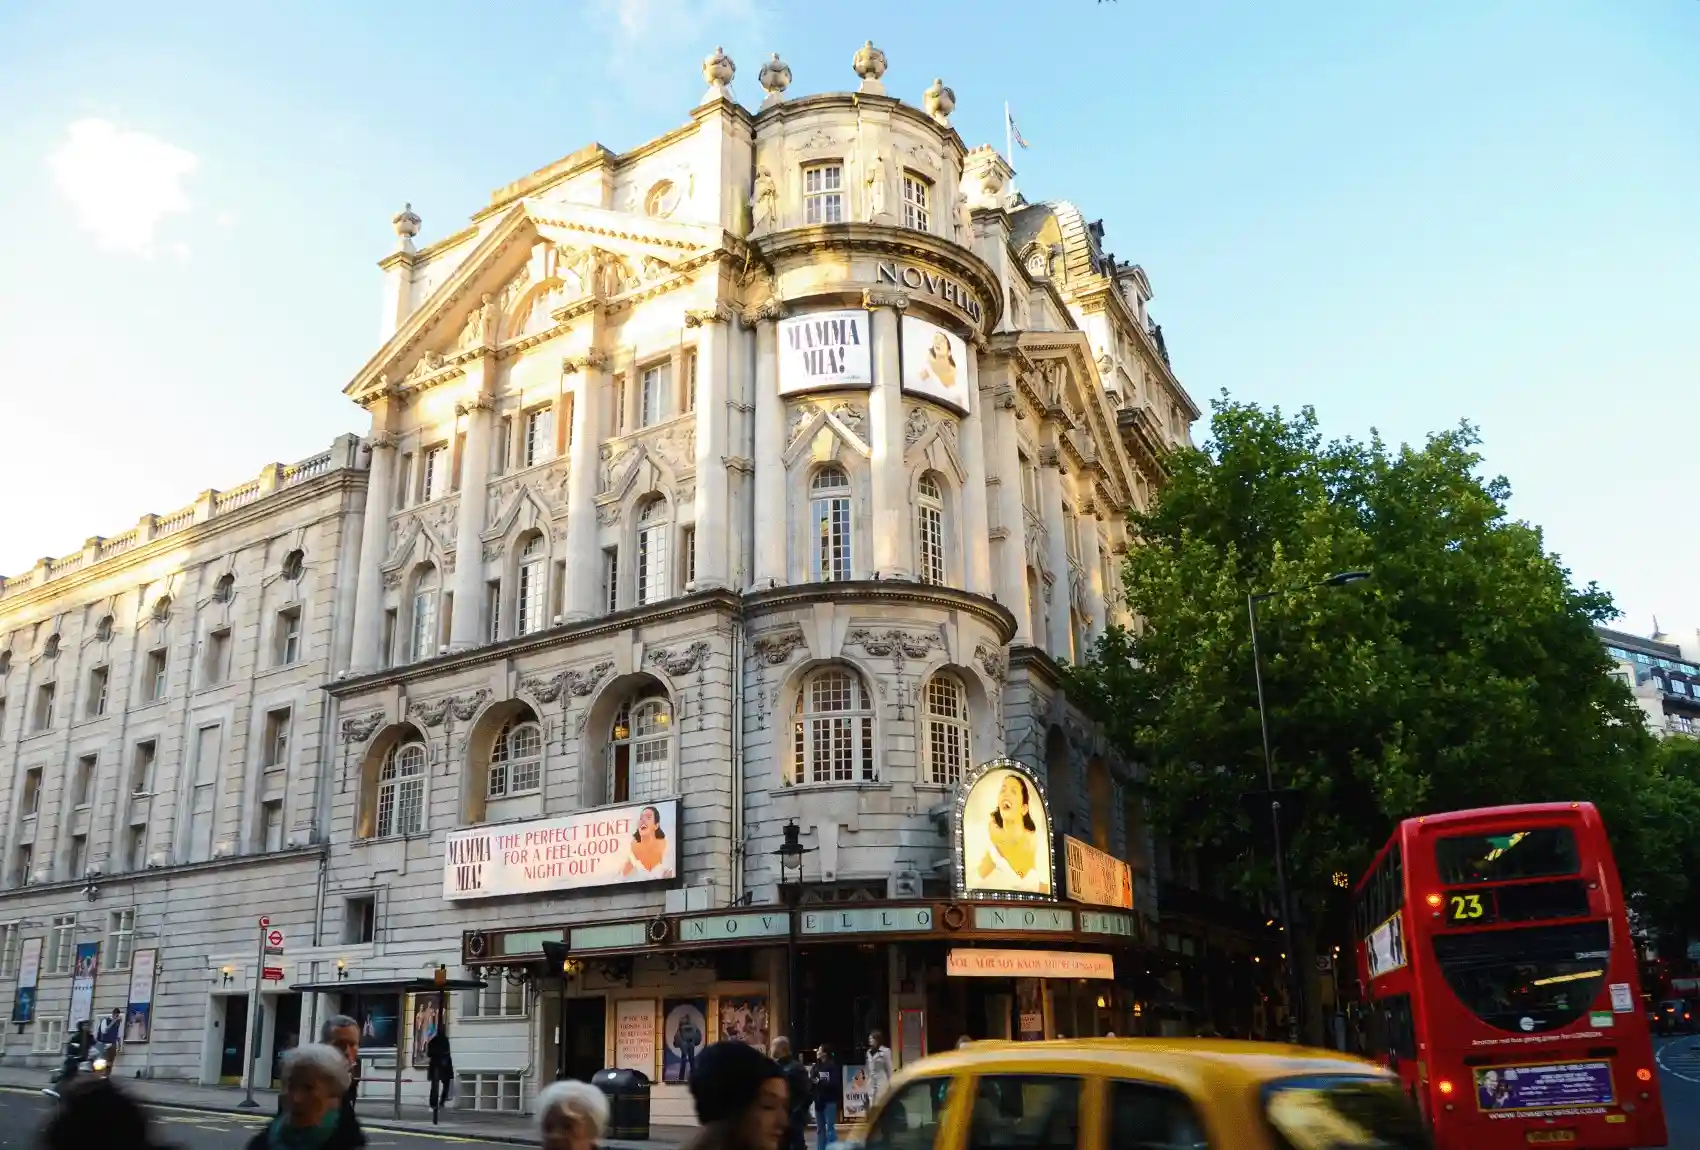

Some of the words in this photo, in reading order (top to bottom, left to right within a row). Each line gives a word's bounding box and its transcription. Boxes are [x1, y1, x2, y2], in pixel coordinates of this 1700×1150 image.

[876, 261, 982, 324] NOVELLO
[787, 319, 861, 350] MAMMA
[803, 346, 846, 377] MIA!
[525, 826, 579, 846] PERFECT
[584, 819, 632, 838] TICKET
[448, 836, 491, 865] MAMMA
[504, 850, 528, 865] FOR
[533, 848, 541, 861] A
[456, 864, 482, 891] MIA!
[524, 862, 564, 880] NIGHT
[1451, 894, 1484, 920] 23
[694, 911, 930, 934] NOVELLO
